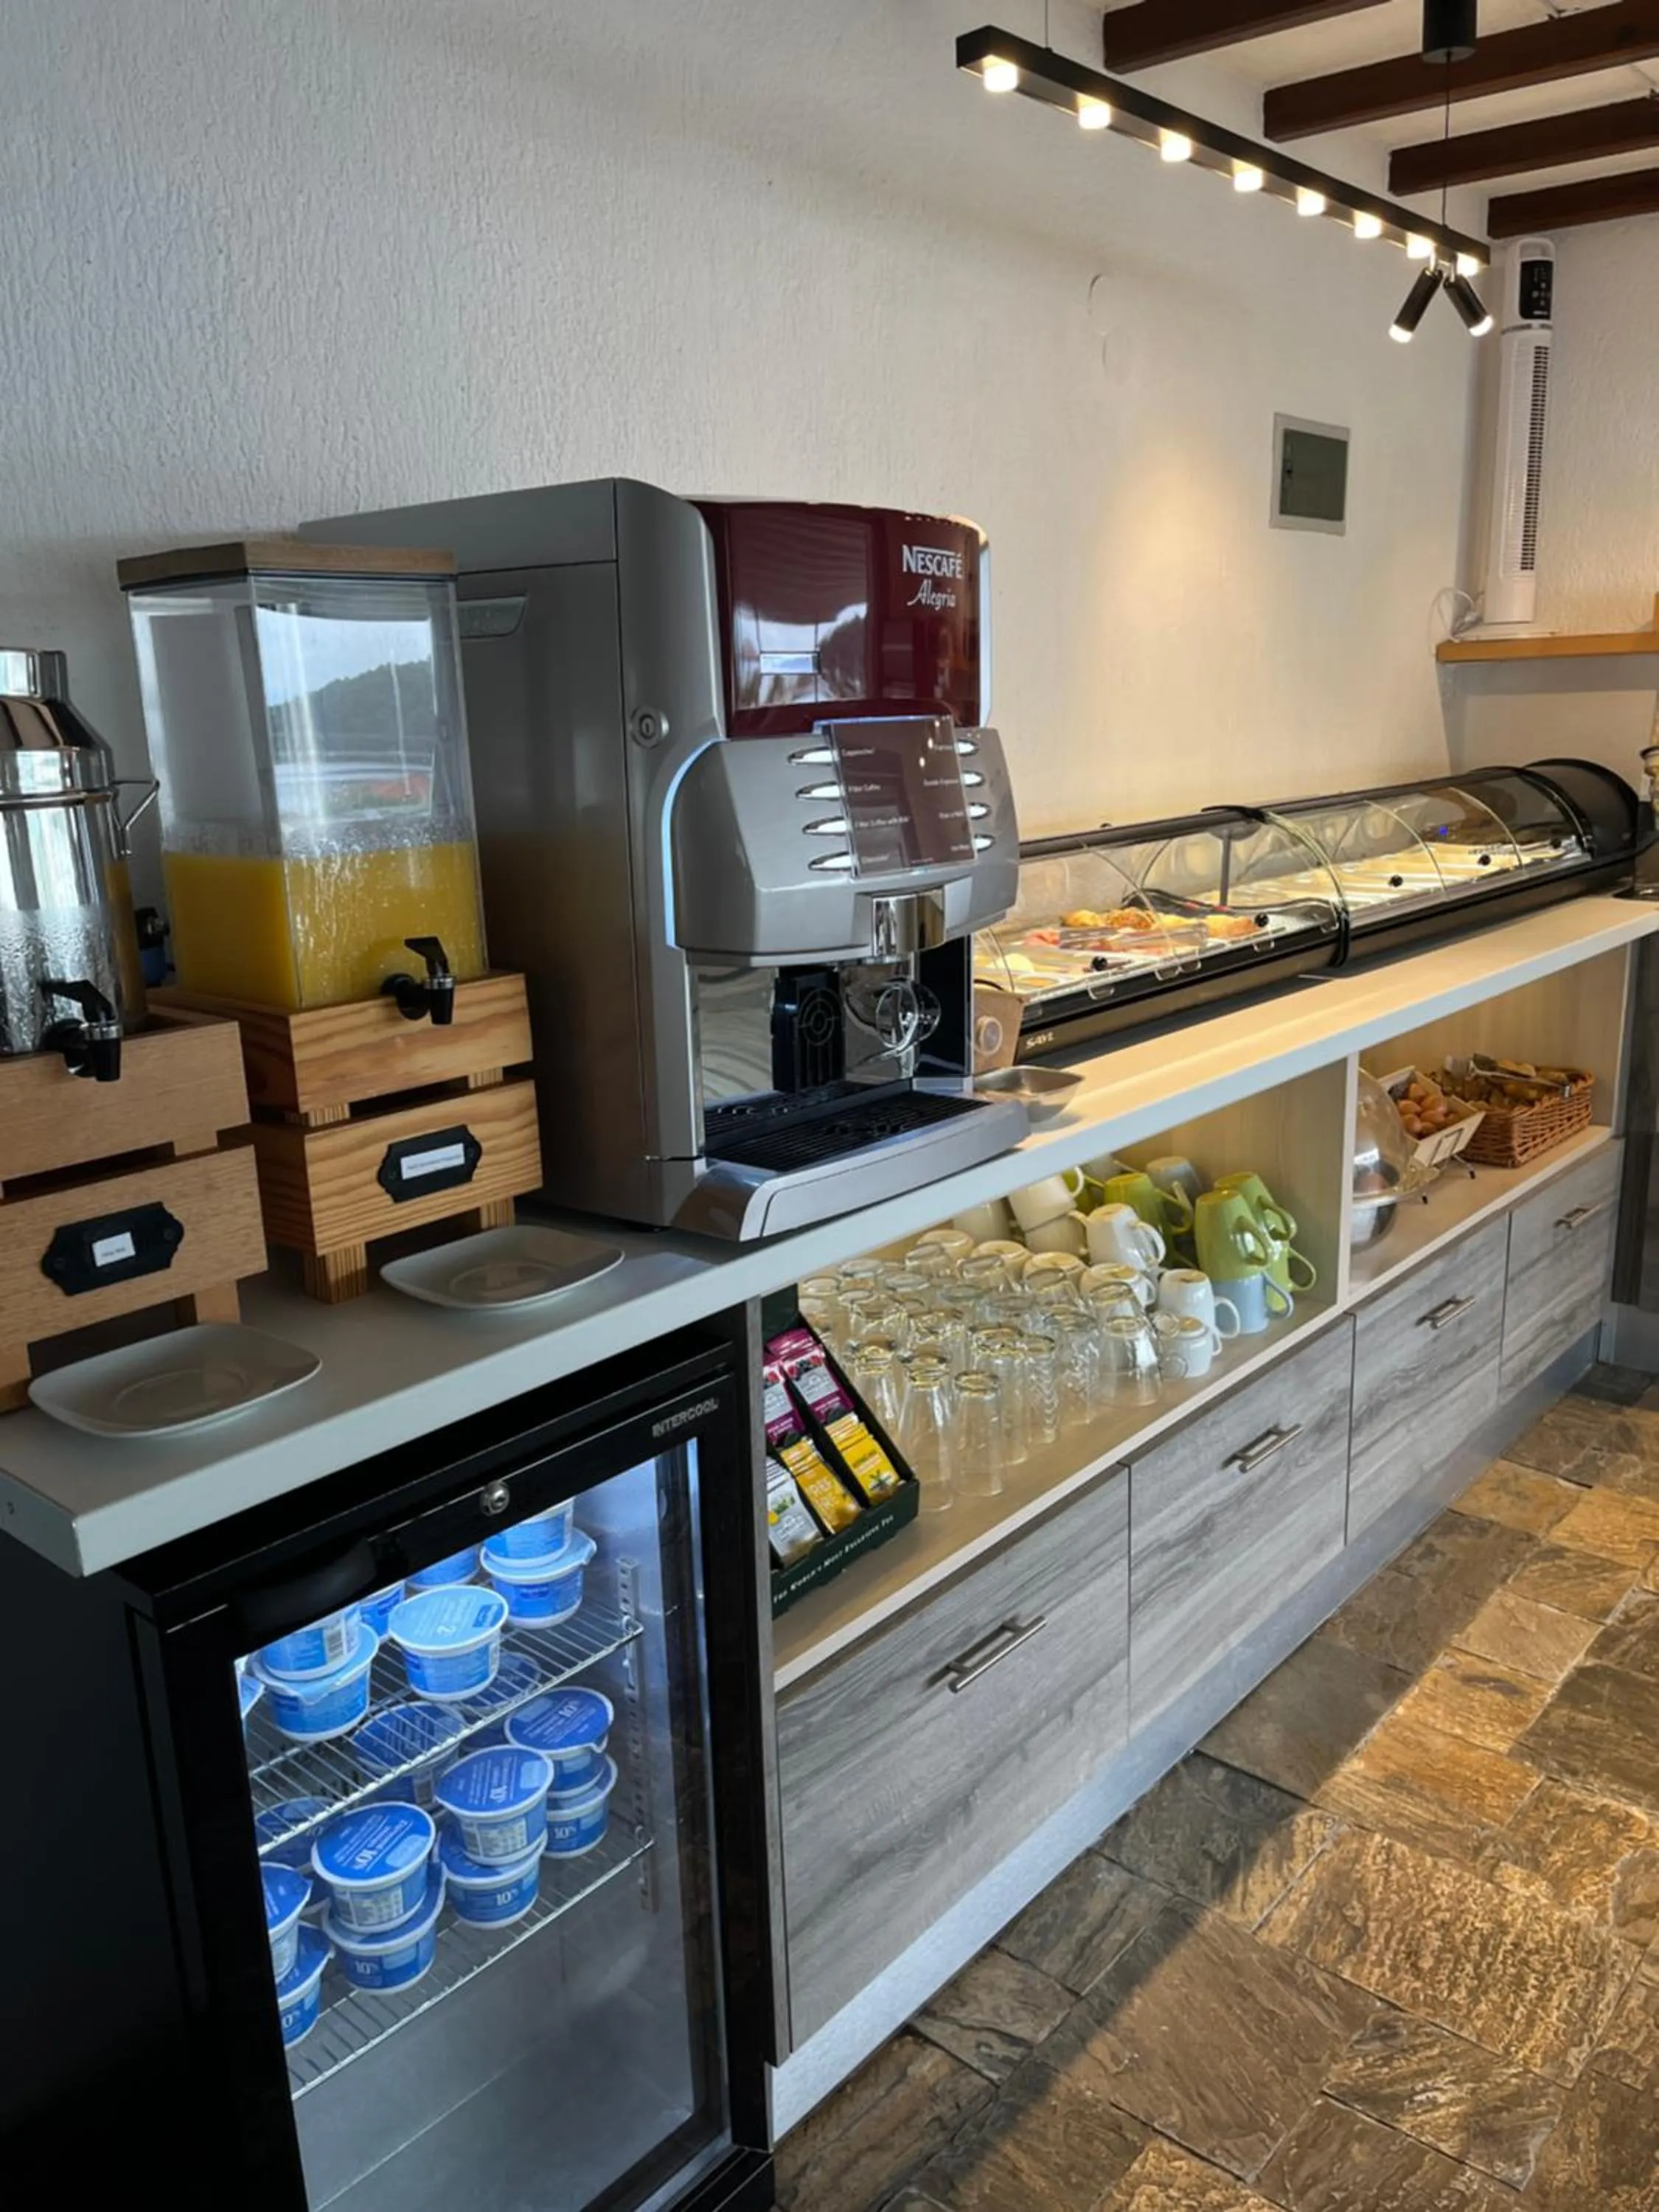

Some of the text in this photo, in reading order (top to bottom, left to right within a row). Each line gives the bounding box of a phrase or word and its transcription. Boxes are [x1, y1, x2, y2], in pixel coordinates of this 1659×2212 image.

[902, 544, 963, 579] NESCAFÉ
[906, 578, 956, 611] Alegria
[652, 1397, 719, 1439] INTERCOOL
